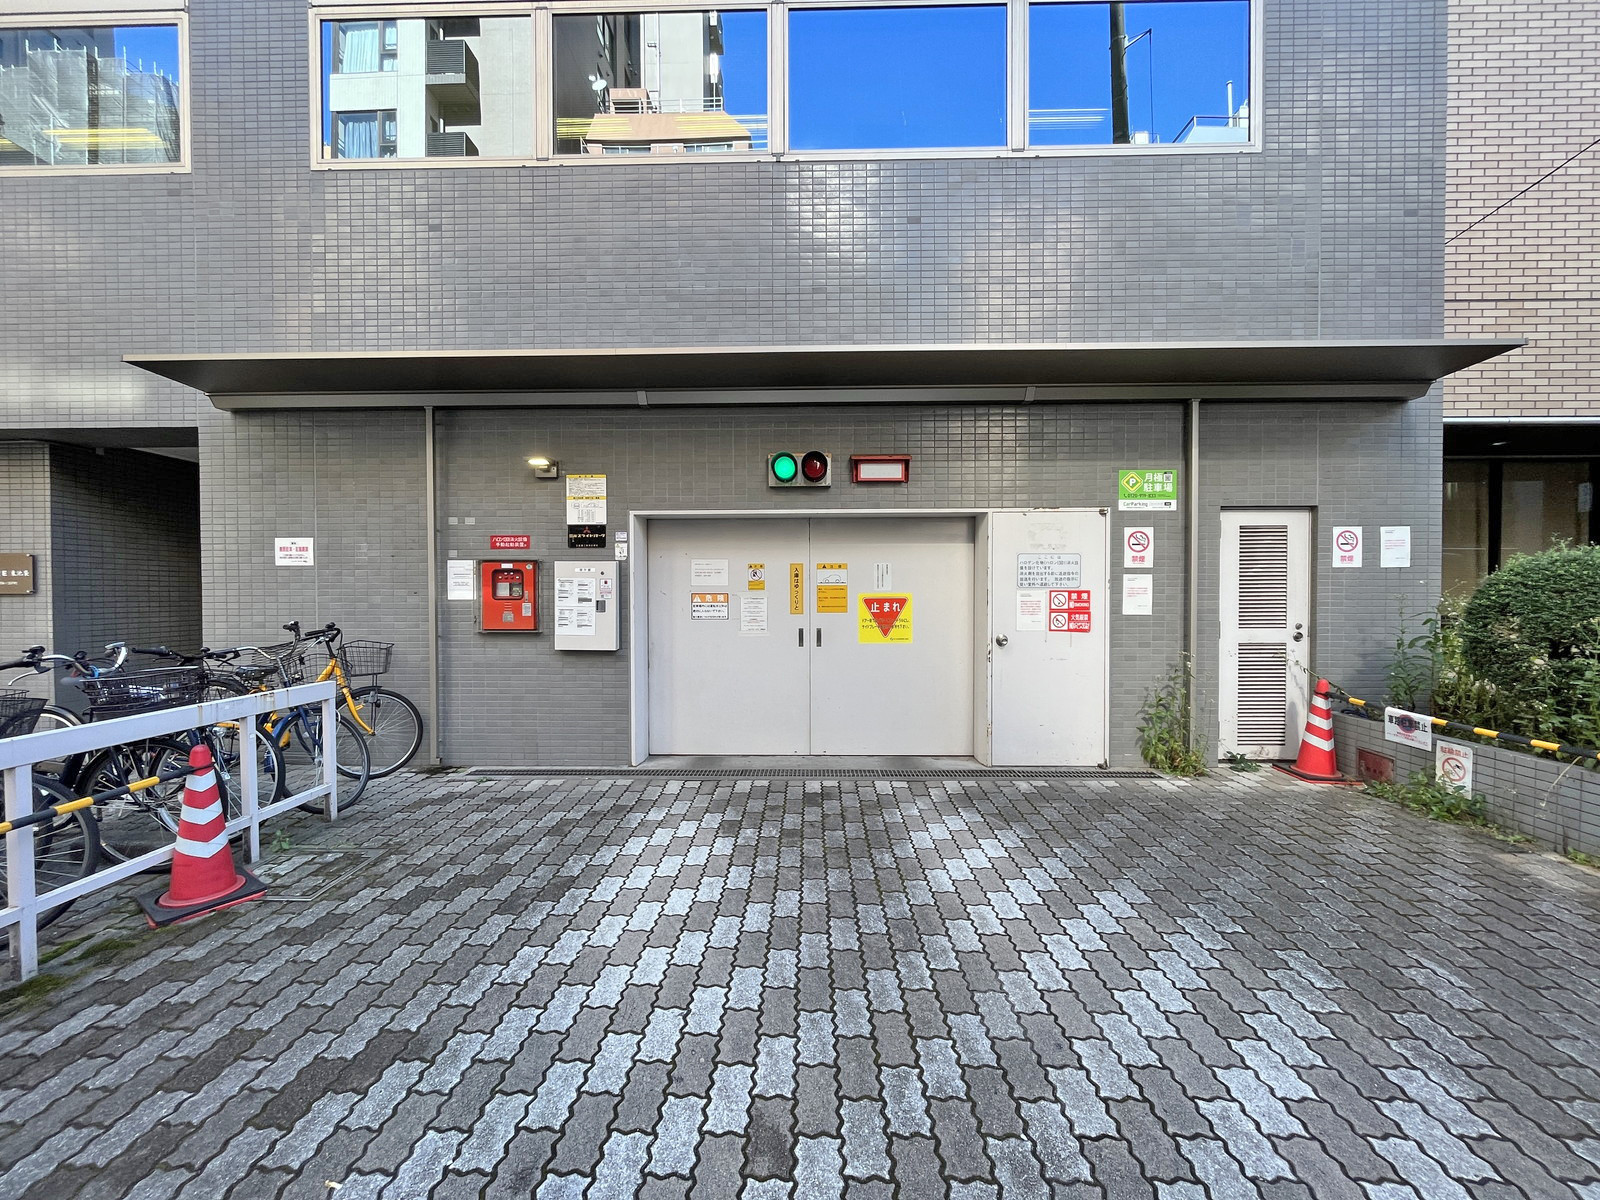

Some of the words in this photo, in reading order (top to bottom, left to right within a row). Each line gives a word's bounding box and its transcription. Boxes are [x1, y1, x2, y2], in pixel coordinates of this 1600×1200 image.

[1144, 472, 1163, 482] 月極
[1143, 482, 1173, 493] 駐車場
[870, 602, 901, 613] 止まれ
